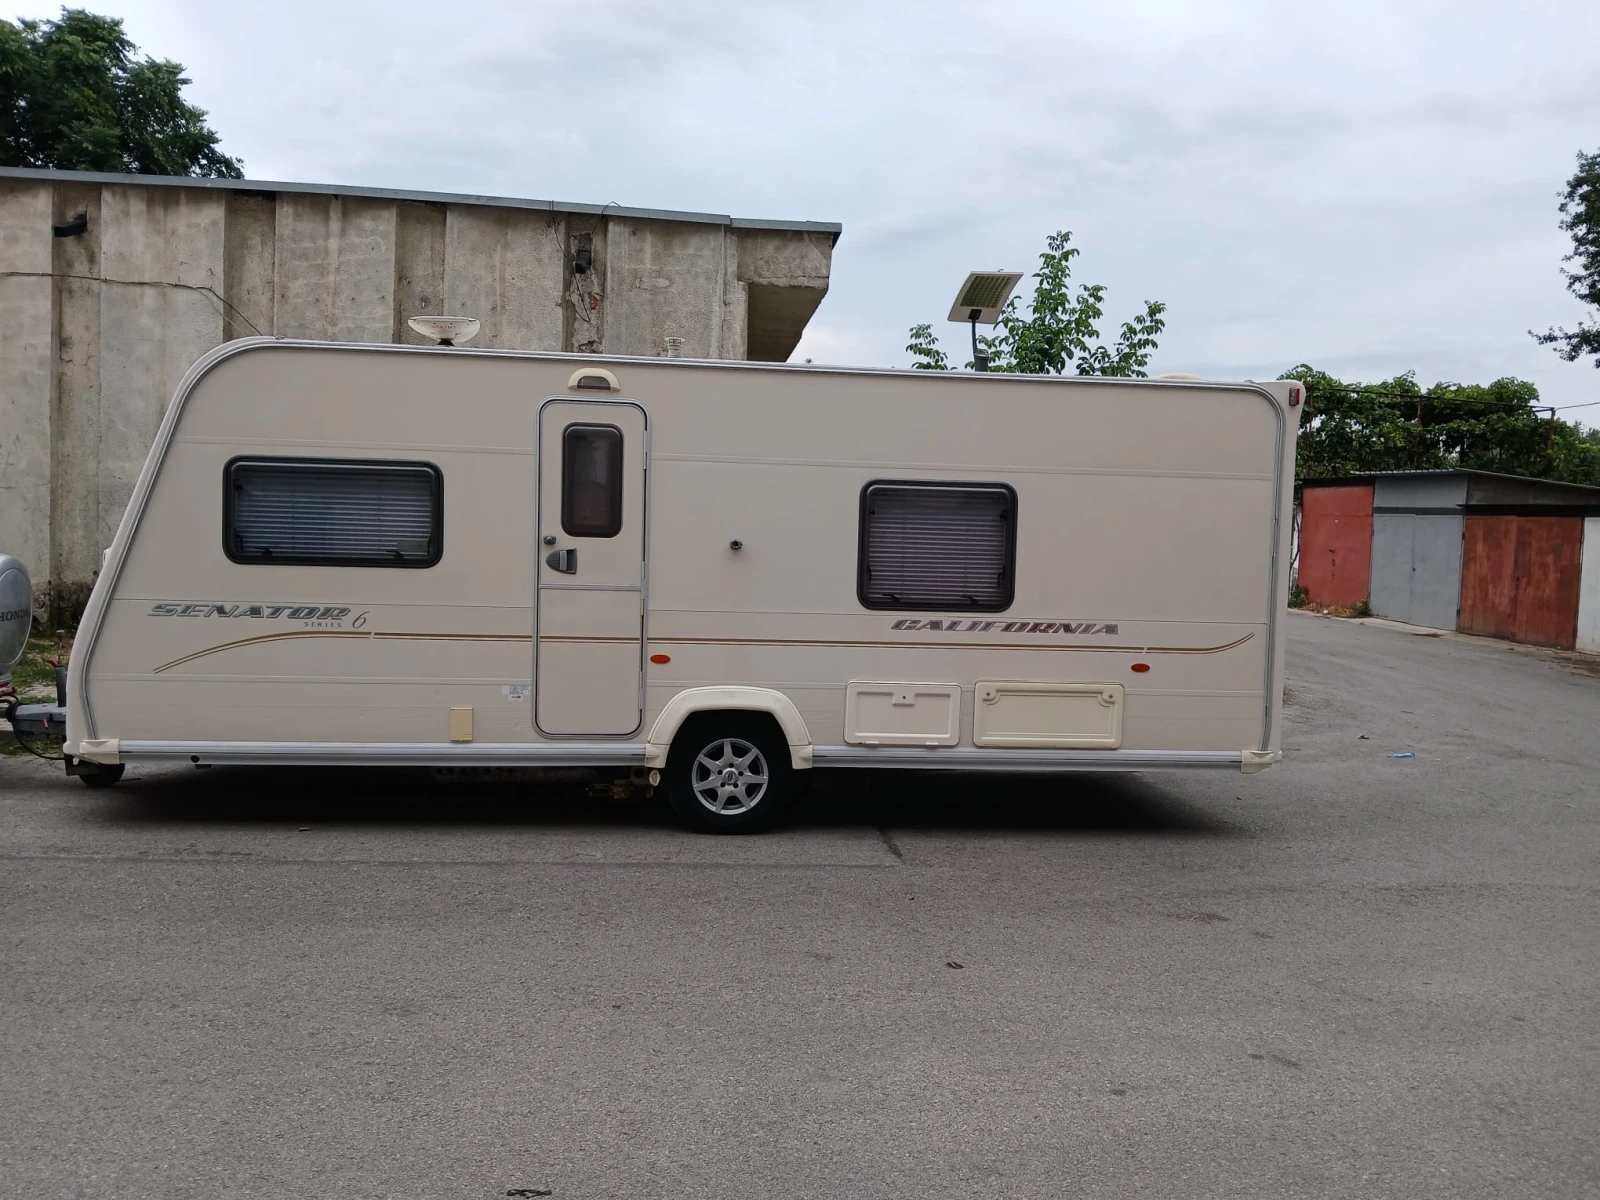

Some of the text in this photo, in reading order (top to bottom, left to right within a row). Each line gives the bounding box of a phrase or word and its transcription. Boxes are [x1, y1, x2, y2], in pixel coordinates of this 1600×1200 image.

[147, 603, 351, 620] SENATOR
[352, 611, 370, 628] 6
[891, 619, 1119, 635] CALIFORNIA
